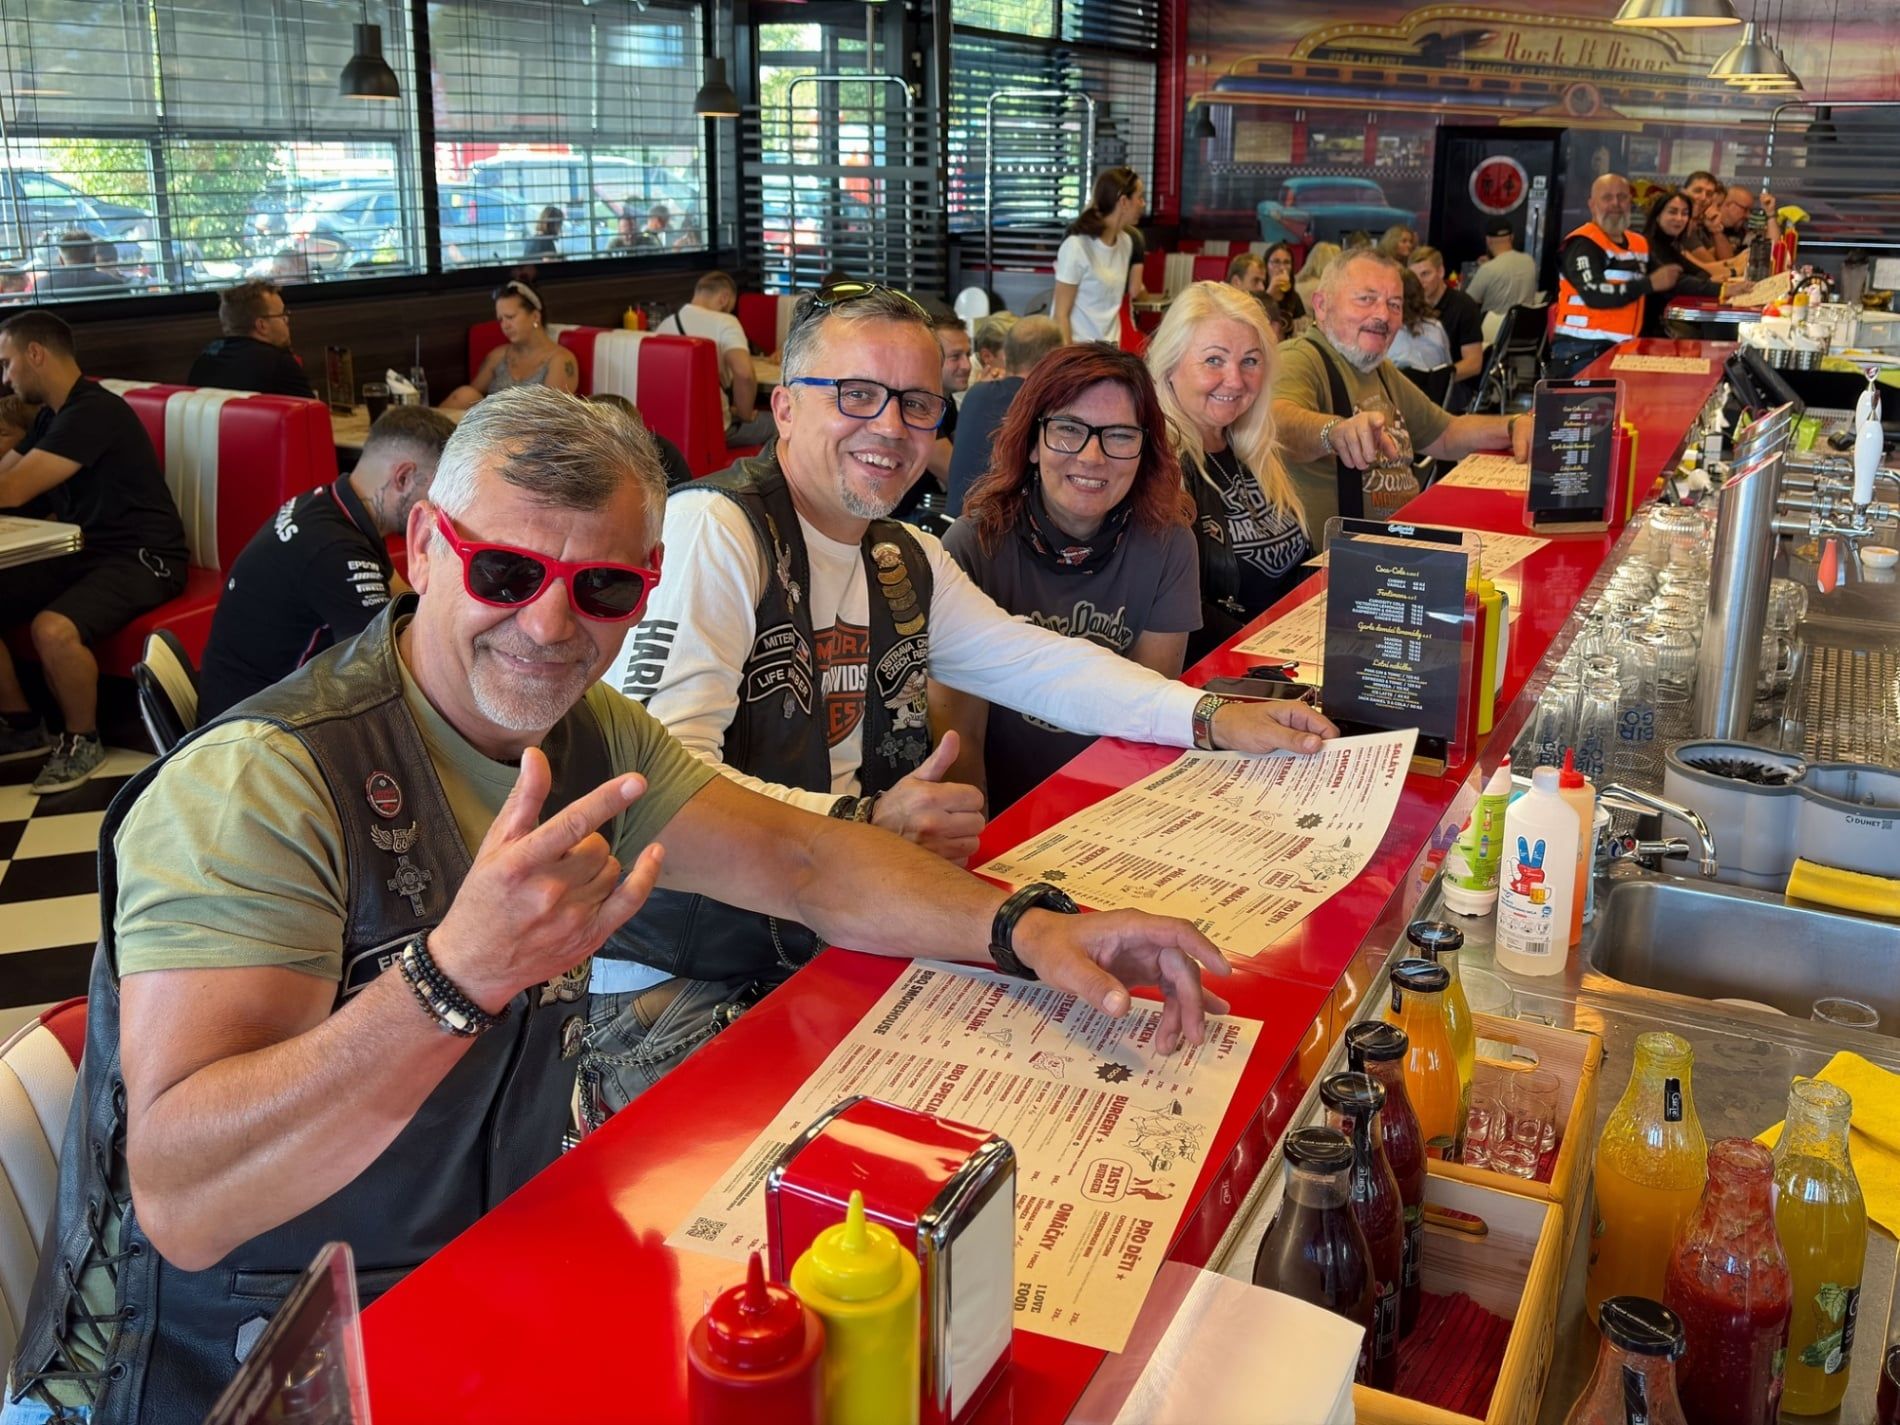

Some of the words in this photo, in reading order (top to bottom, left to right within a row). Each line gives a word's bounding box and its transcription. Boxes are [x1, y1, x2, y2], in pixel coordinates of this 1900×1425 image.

[880, 641, 915, 672] OSTRAVA
[885, 654, 911, 681] CZECH
[757, 669, 785, 688] LIFE
[1332, 749, 1352, 789] CHICKEN
[1386, 742, 1403, 780] SALÁTY
[913, 969, 936, 985] BBQ
[871, 984, 924, 1035] SMOKEHOUSE
[983, 982, 1013, 1007] PÁRTY
[1049, 993, 1079, 1023] STEAKY
[964, 1007, 995, 1032] TALÍŘE
[1136, 1010, 1165, 1043] CHICKEN
[1216, 1024, 1244, 1054] SALÁTY
[942, 1062, 969, 1082] BBQ
[1105, 1066, 1122, 1080] FOOD
[1094, 1094, 1130, 1137] BURGERY
[1089, 1163, 1109, 1194] BURGER
[1101, 1165, 1124, 1199] TASTY
[1038, 1203, 1075, 1251] OMÁČKY
[1128, 1218, 1154, 1244] PRO
[1117, 1245, 1142, 1273] DĚTI
[1014, 1281, 1032, 1312] FOOD
[1030, 1289, 1046, 1314] LOVE
